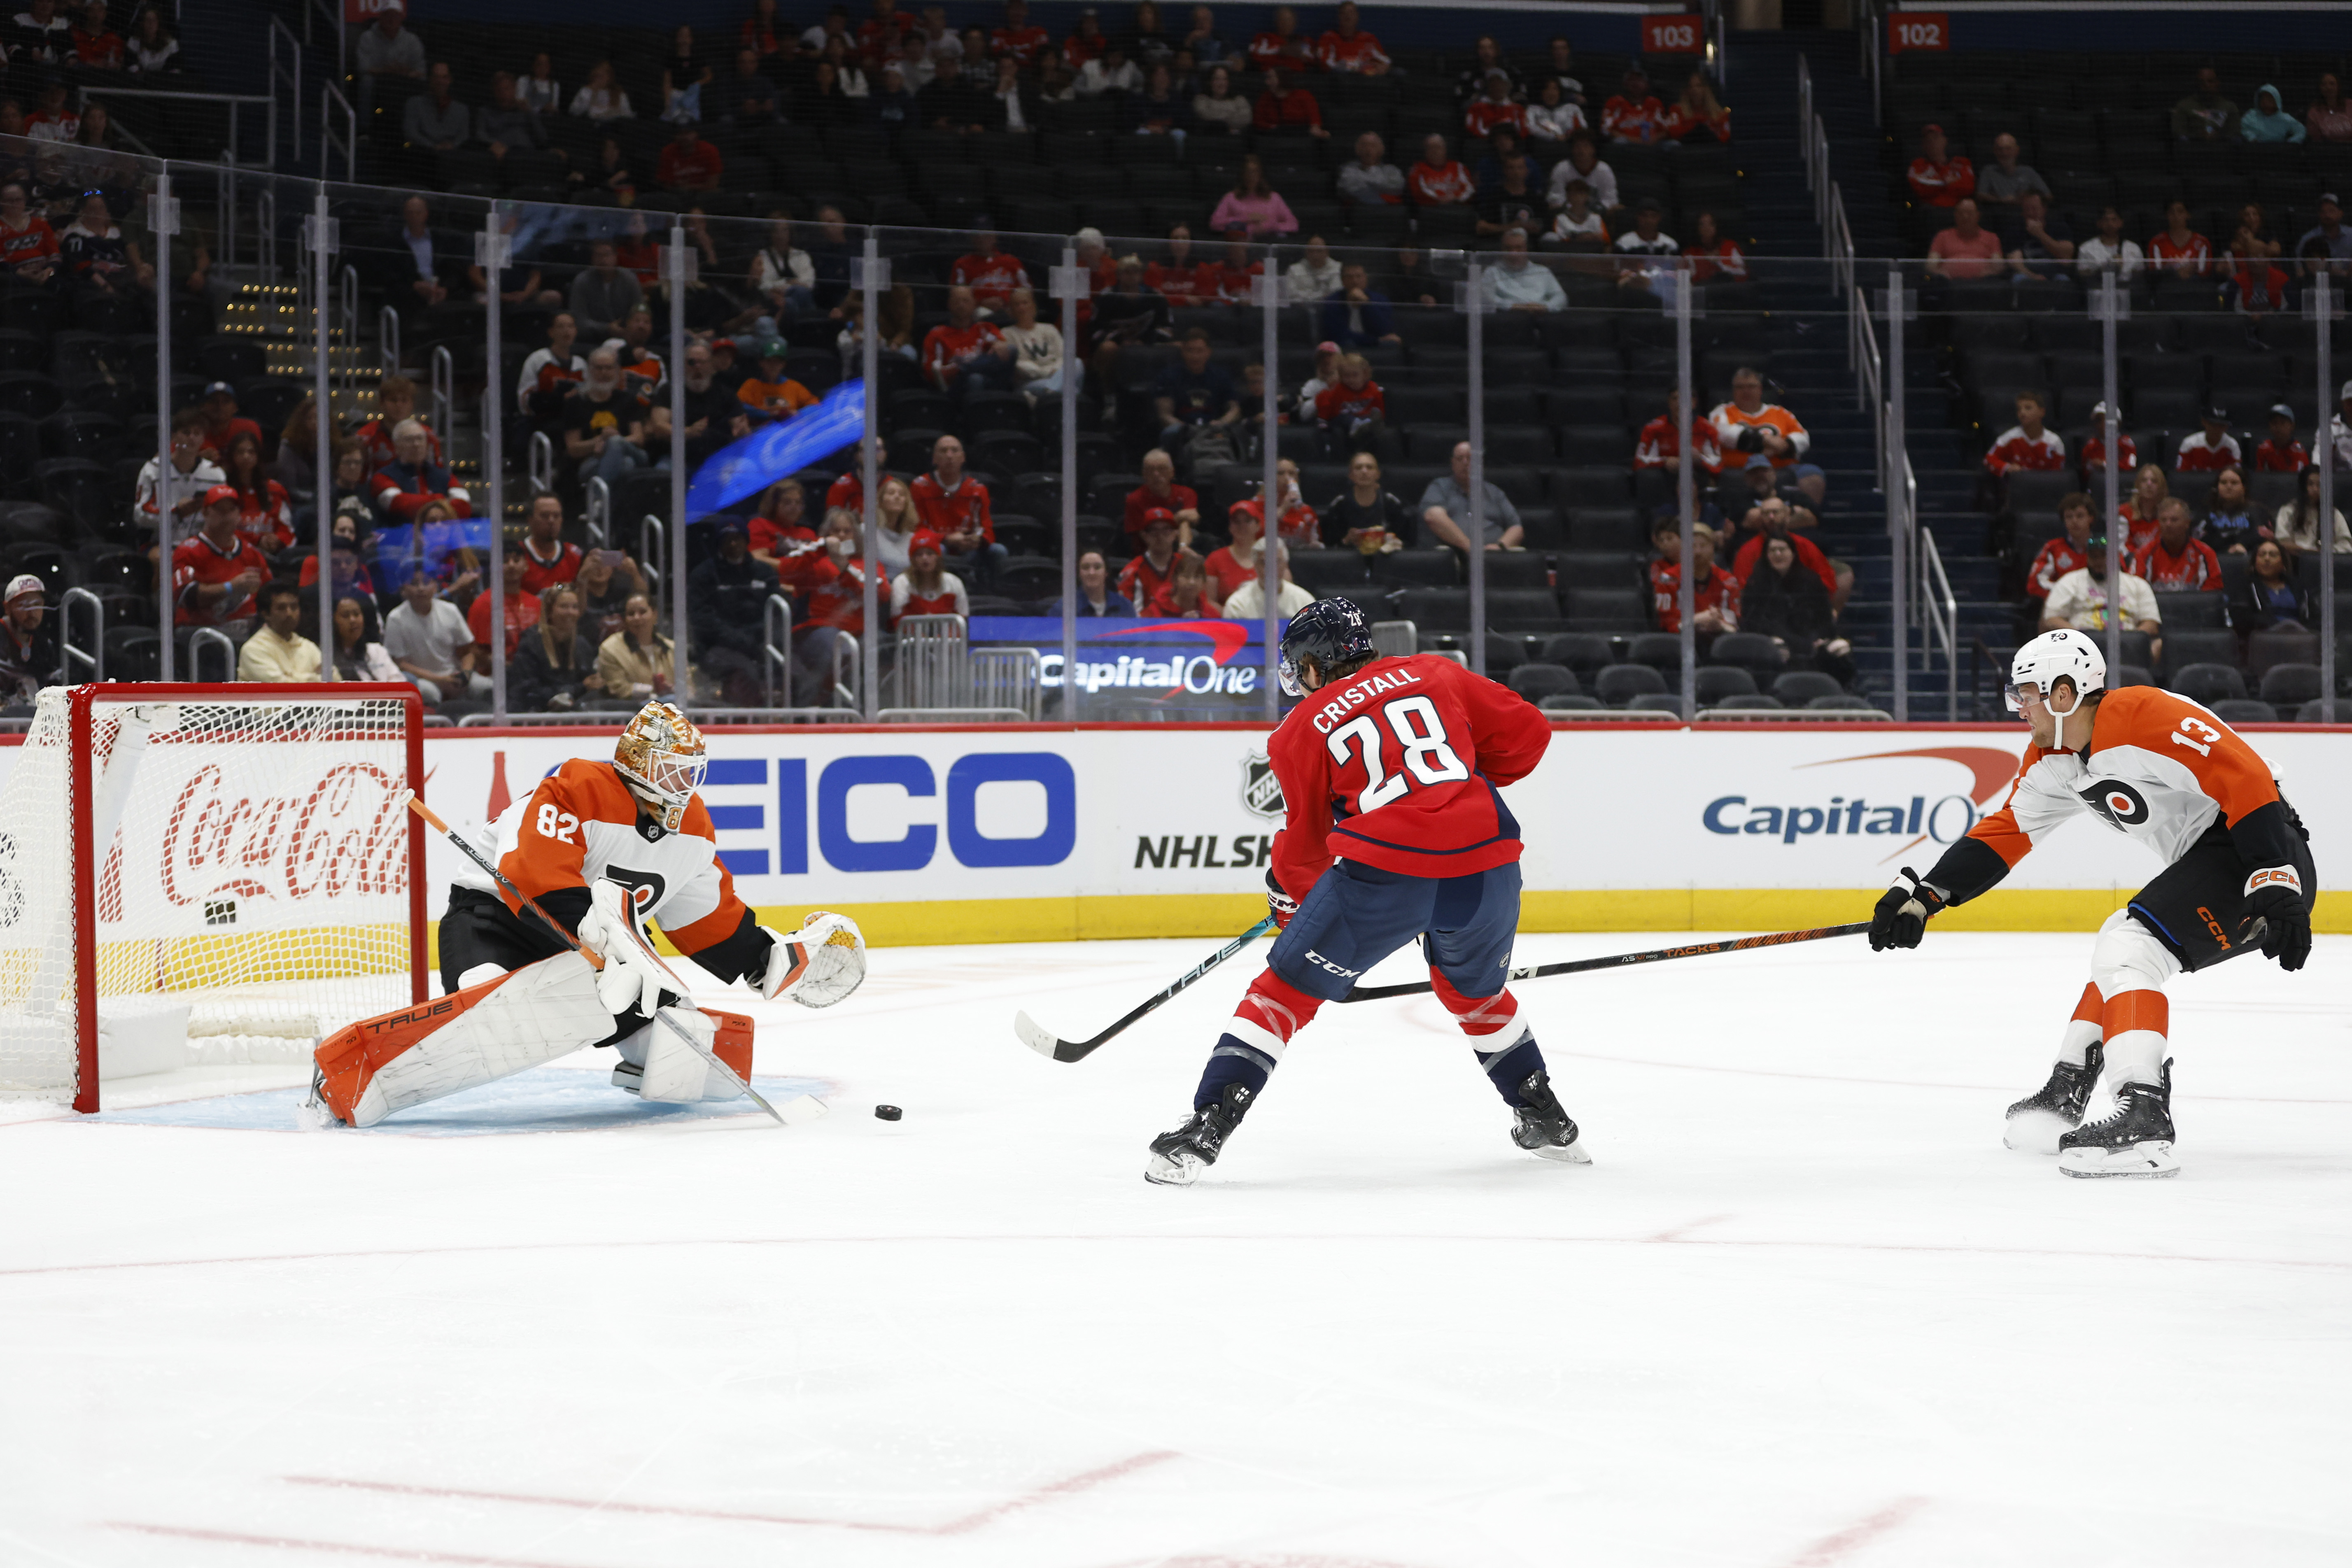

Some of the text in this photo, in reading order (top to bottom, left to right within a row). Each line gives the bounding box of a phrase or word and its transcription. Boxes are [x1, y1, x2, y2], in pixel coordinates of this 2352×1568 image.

[1651, 25, 1694, 48] 103
[1898, 23, 1941, 46] 102
[1347, 612, 1363, 627] 28
[1312, 668, 1422, 734] CRISTALL
[1326, 694, 1471, 815] 28
[2170, 717, 2221, 757] 13
[536, 804, 579, 845] 82
[694, 752, 1076, 875] EICO
[1703, 795, 1985, 845] CapitalO
[2197, 906, 2232, 951] CCM
[1157, 936, 1240, 998] TRUE
[1305, 948, 1361, 978] CCM
[1663, 943, 1720, 958] TACKS
[366, 1000, 453, 1034] TRUE
